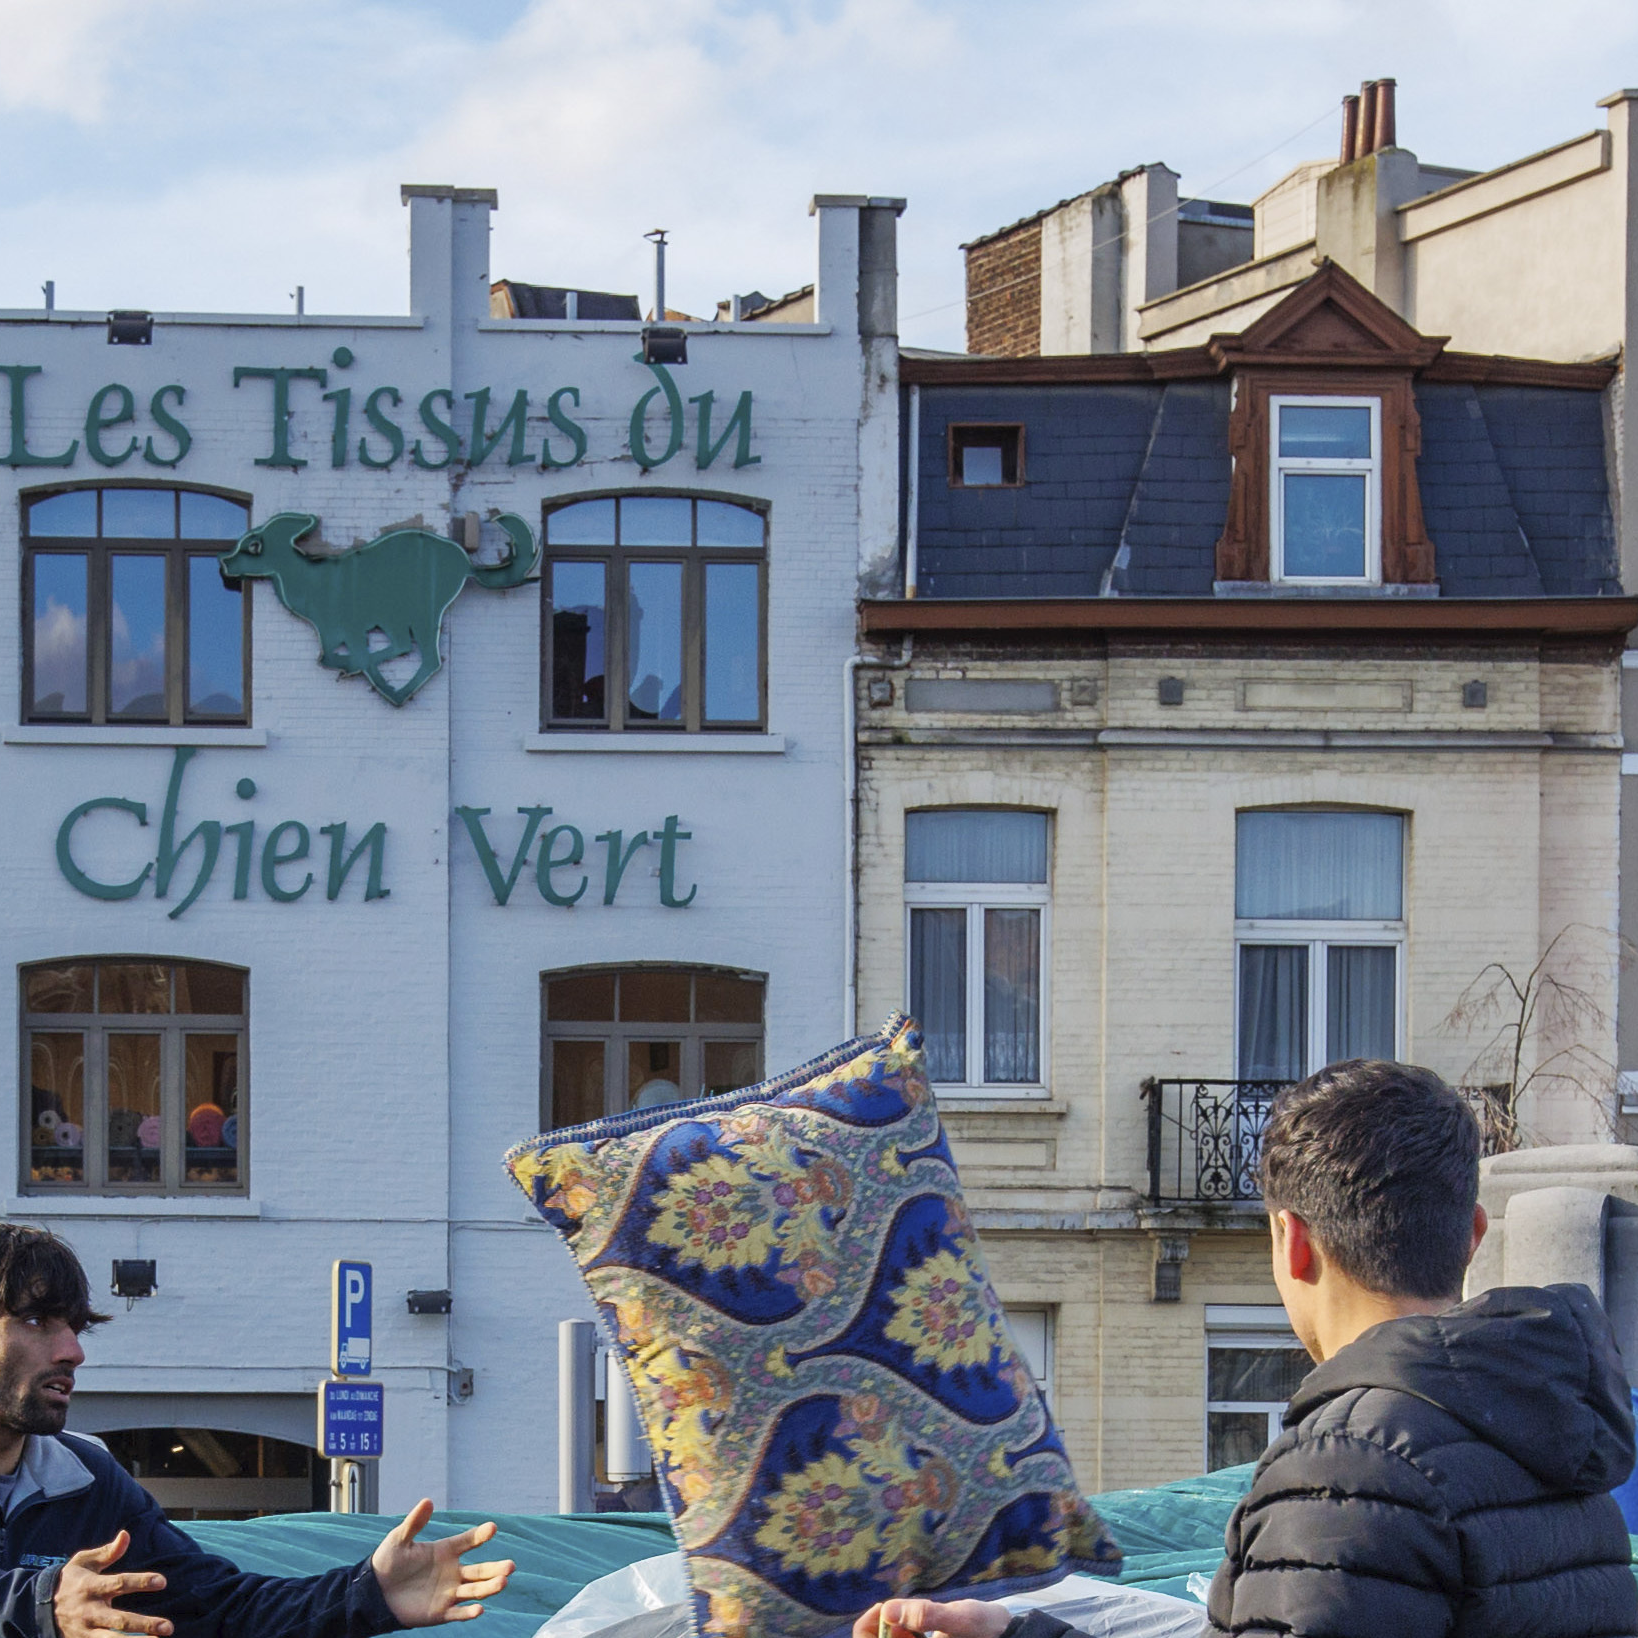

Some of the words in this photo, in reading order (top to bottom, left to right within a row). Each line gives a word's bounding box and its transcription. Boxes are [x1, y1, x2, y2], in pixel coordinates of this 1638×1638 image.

[233, 346, 587, 469] Tissus
[629, 351, 762, 470] du
[56, 747, 390, 919] Chien
[454, 805, 698, 908] Vert
[345, 1269, 365, 1328] P
[340, 1432, 347, 1450] 5
[360, 1432, 370, 1451] 15
